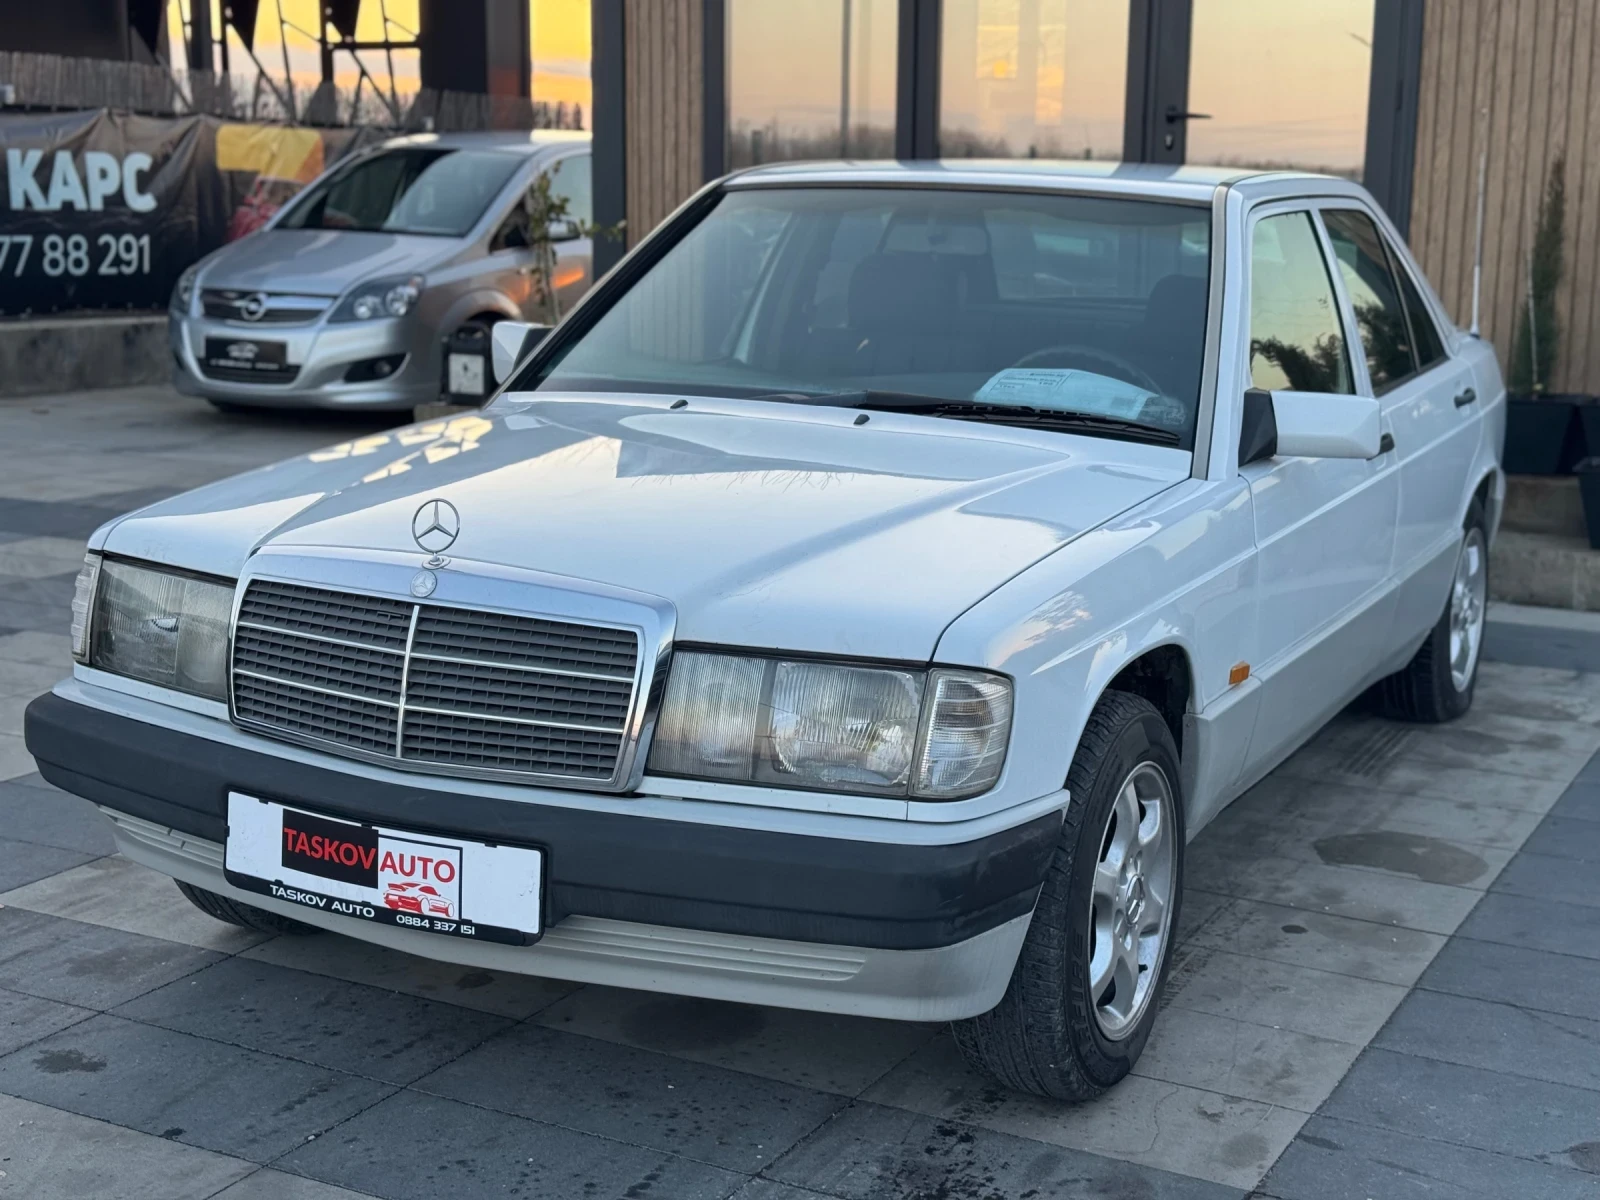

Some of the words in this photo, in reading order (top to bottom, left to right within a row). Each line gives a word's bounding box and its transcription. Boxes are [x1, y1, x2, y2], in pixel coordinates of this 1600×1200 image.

[42, 233, 90, 277] 88
[97, 233, 150, 275] 291
[283, 828, 376, 869] TASKOV
[379, 851, 455, 883] AUTO
[269, 884, 327, 907] TASKOV
[331, 900, 375, 918] AUTO
[396, 914, 431, 929] 0884
[433, 920, 457, 932] 337
[460, 925, 475, 935] 151
